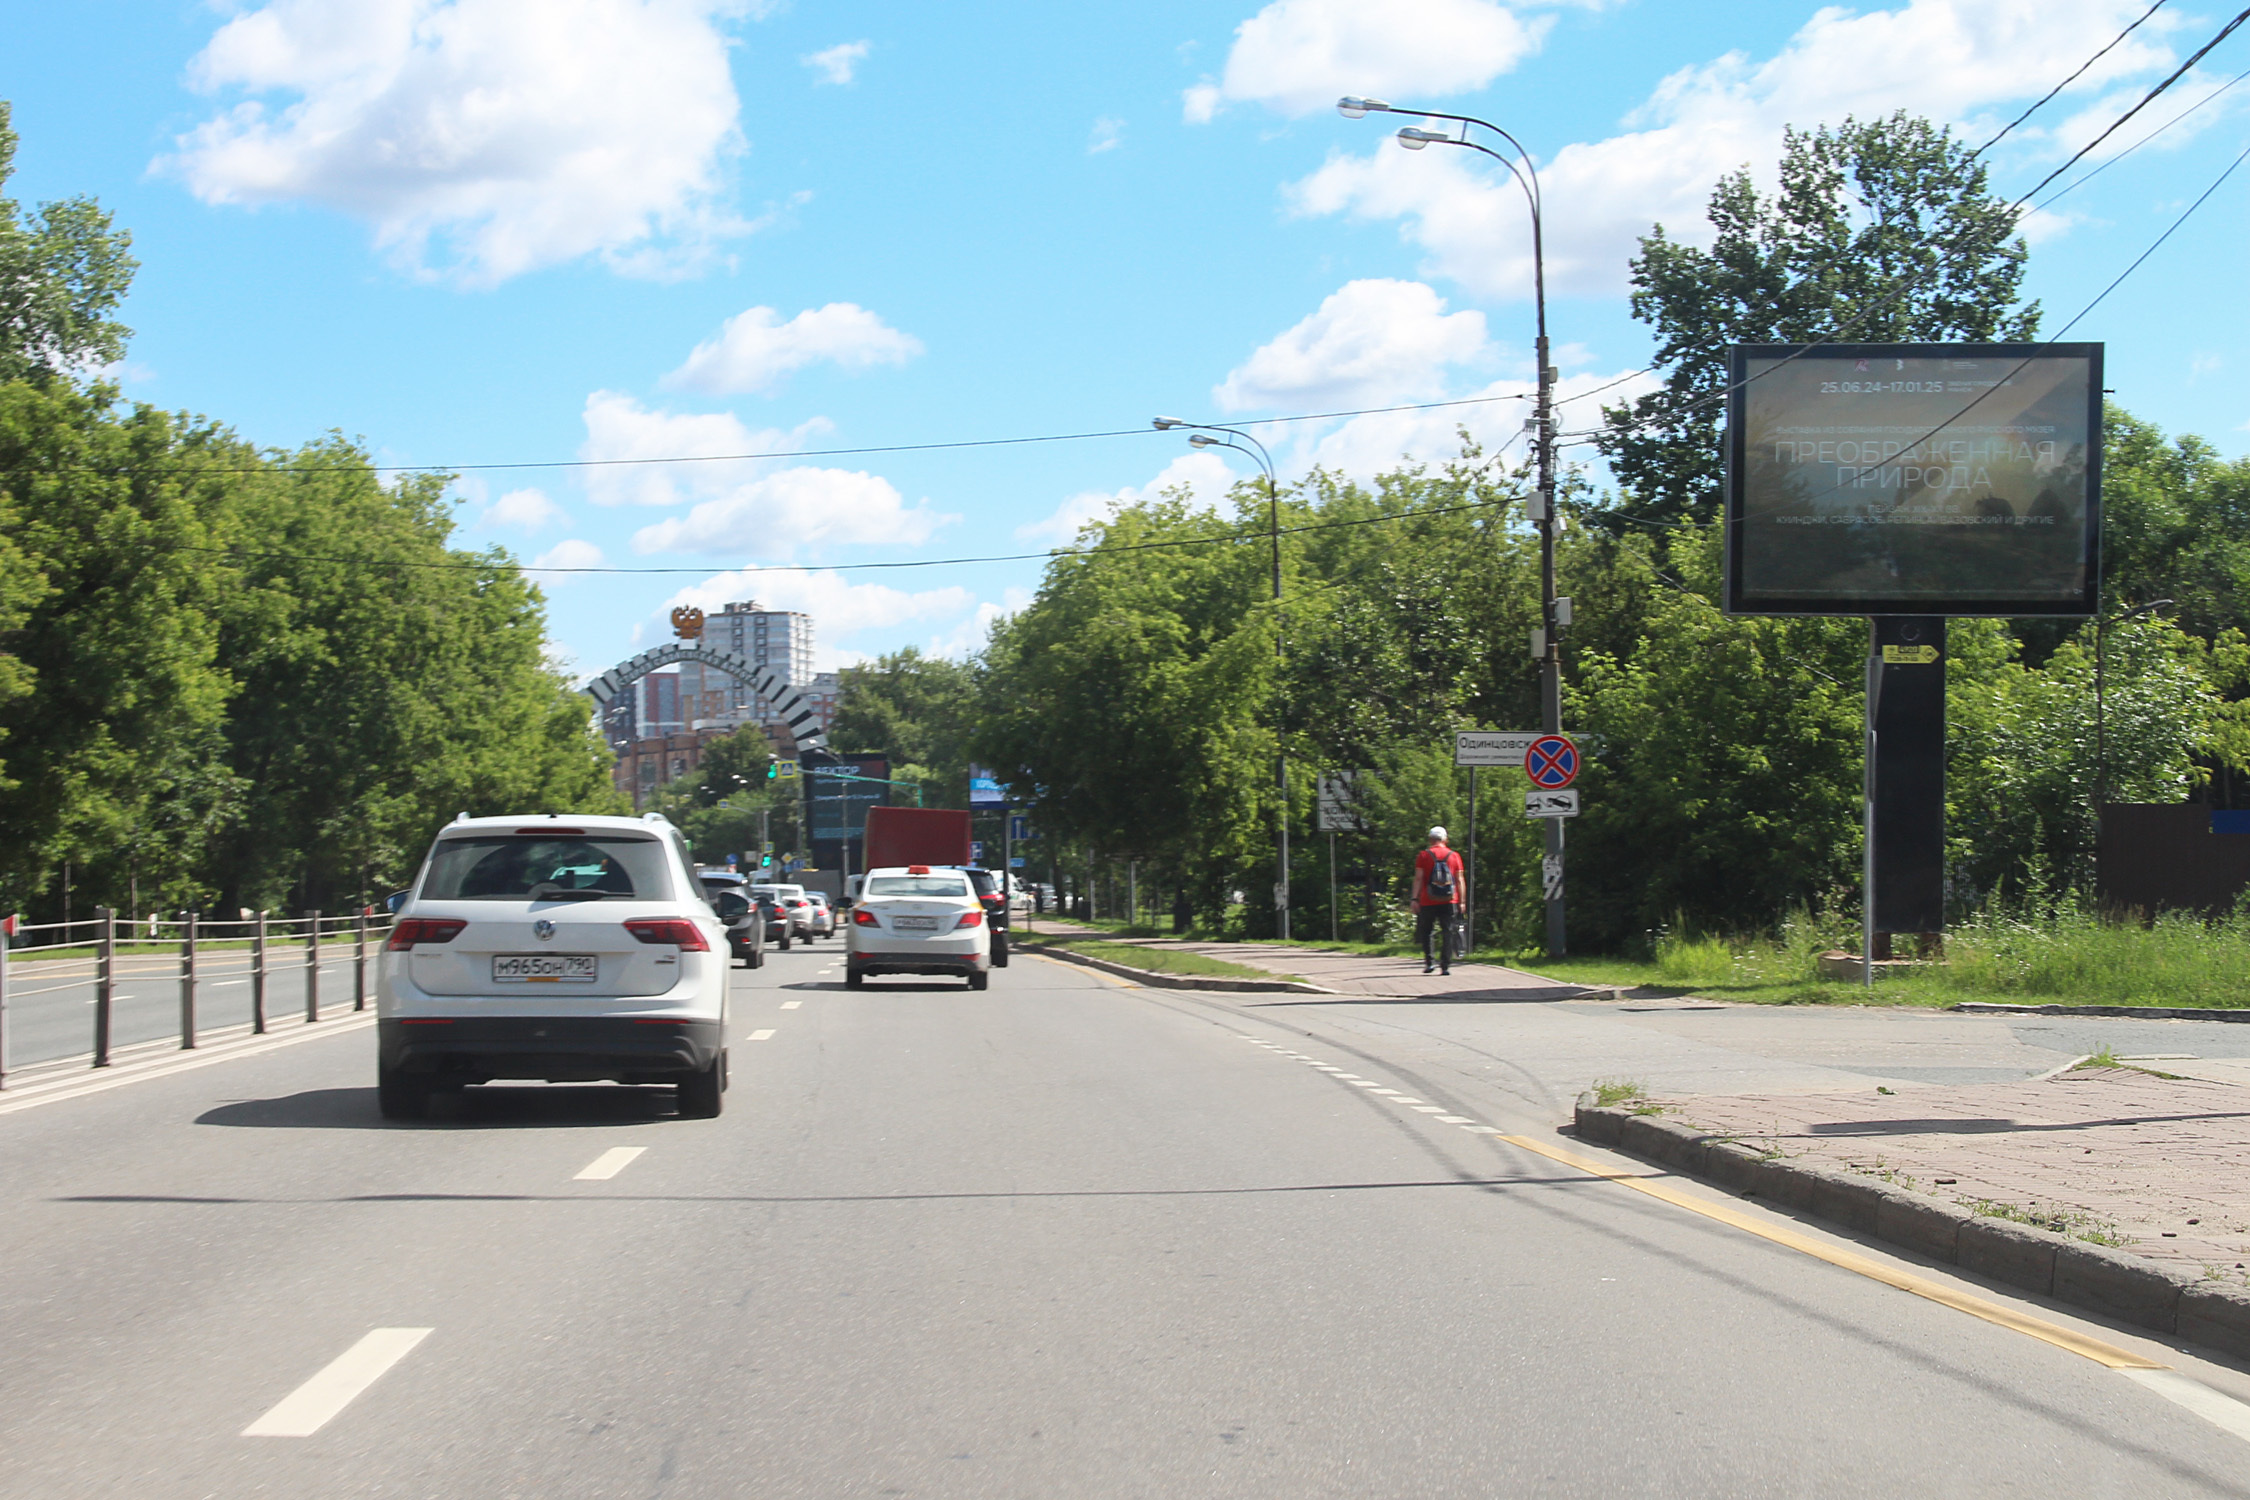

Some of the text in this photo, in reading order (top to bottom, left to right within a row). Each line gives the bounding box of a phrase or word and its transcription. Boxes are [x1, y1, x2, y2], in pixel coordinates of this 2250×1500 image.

[1775, 440, 2055, 464] ПРЕОБРАЖЕННАЯ
[1837, 466, 1993, 493] ПРИРОДА
[1459, 737, 1530, 749] Одинцовск
[567, 958, 592, 970] 790
